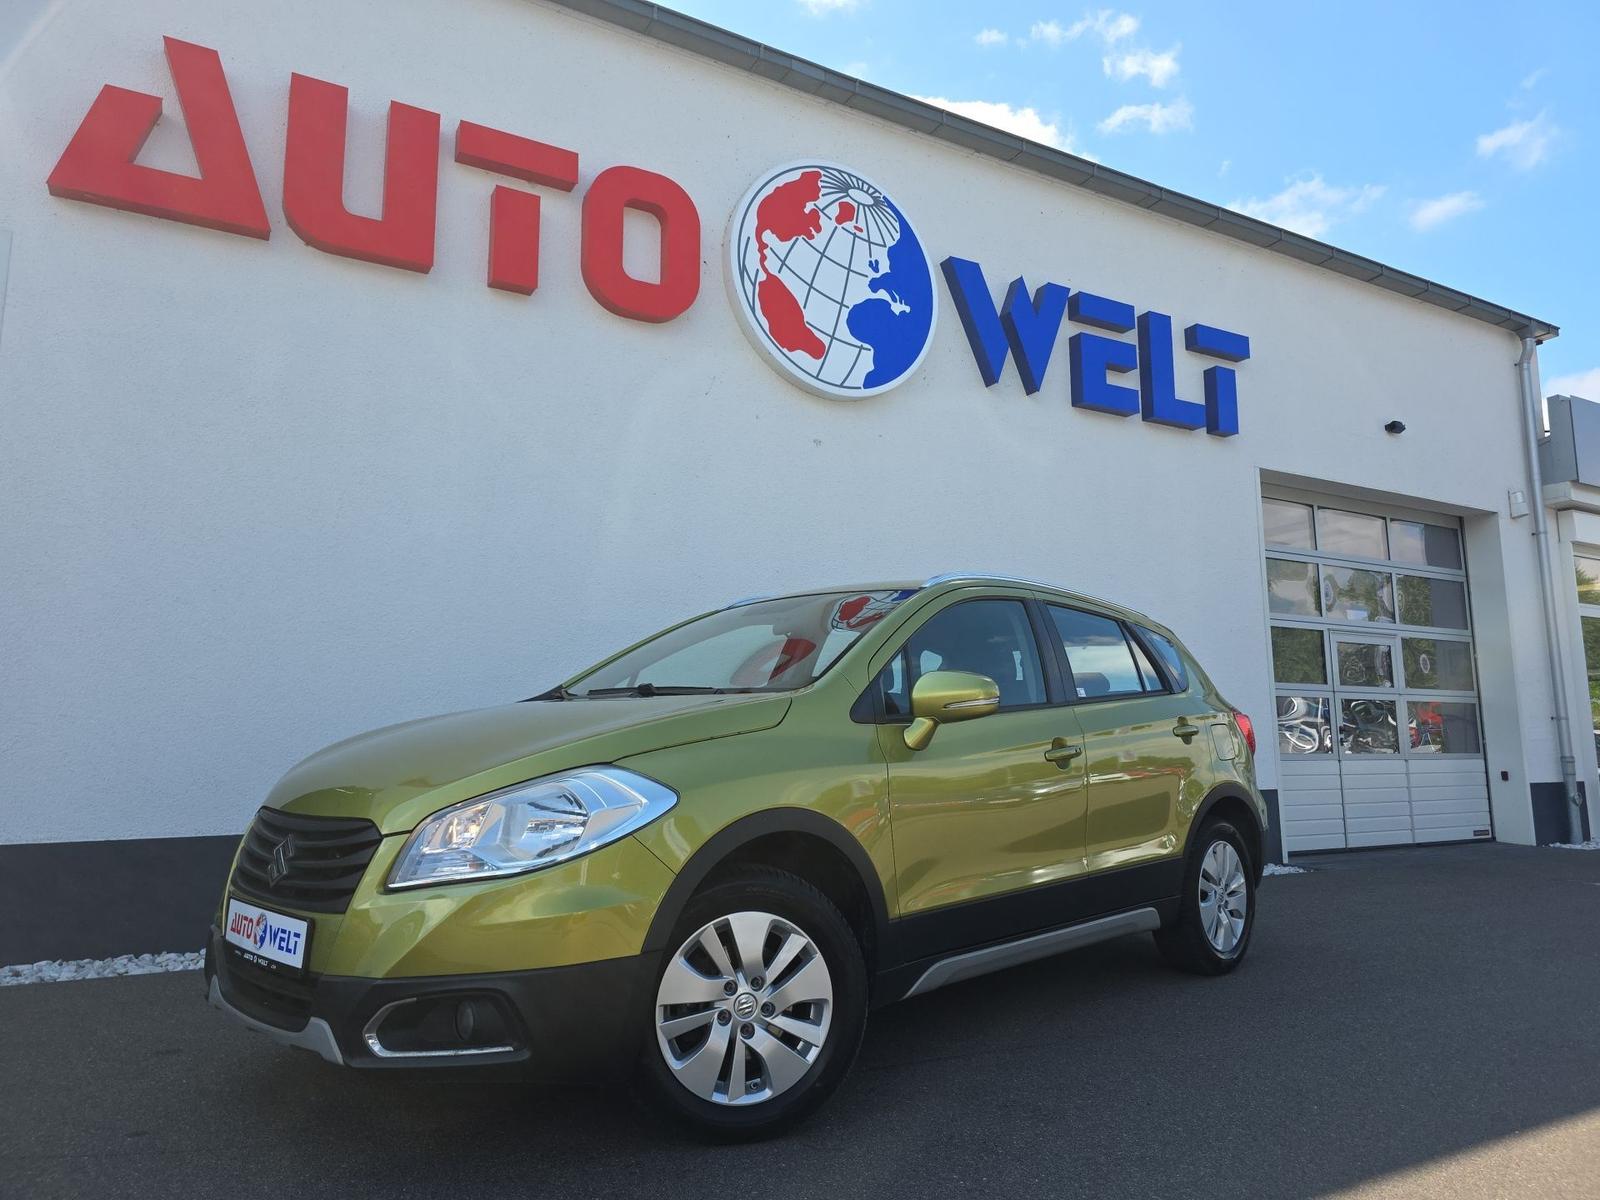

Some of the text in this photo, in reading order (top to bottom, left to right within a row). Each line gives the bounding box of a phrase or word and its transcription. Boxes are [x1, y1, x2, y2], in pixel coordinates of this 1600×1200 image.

[46, 35, 1250, 438] AUTO WELT
[230, 912, 301, 955] AUTO WELT
